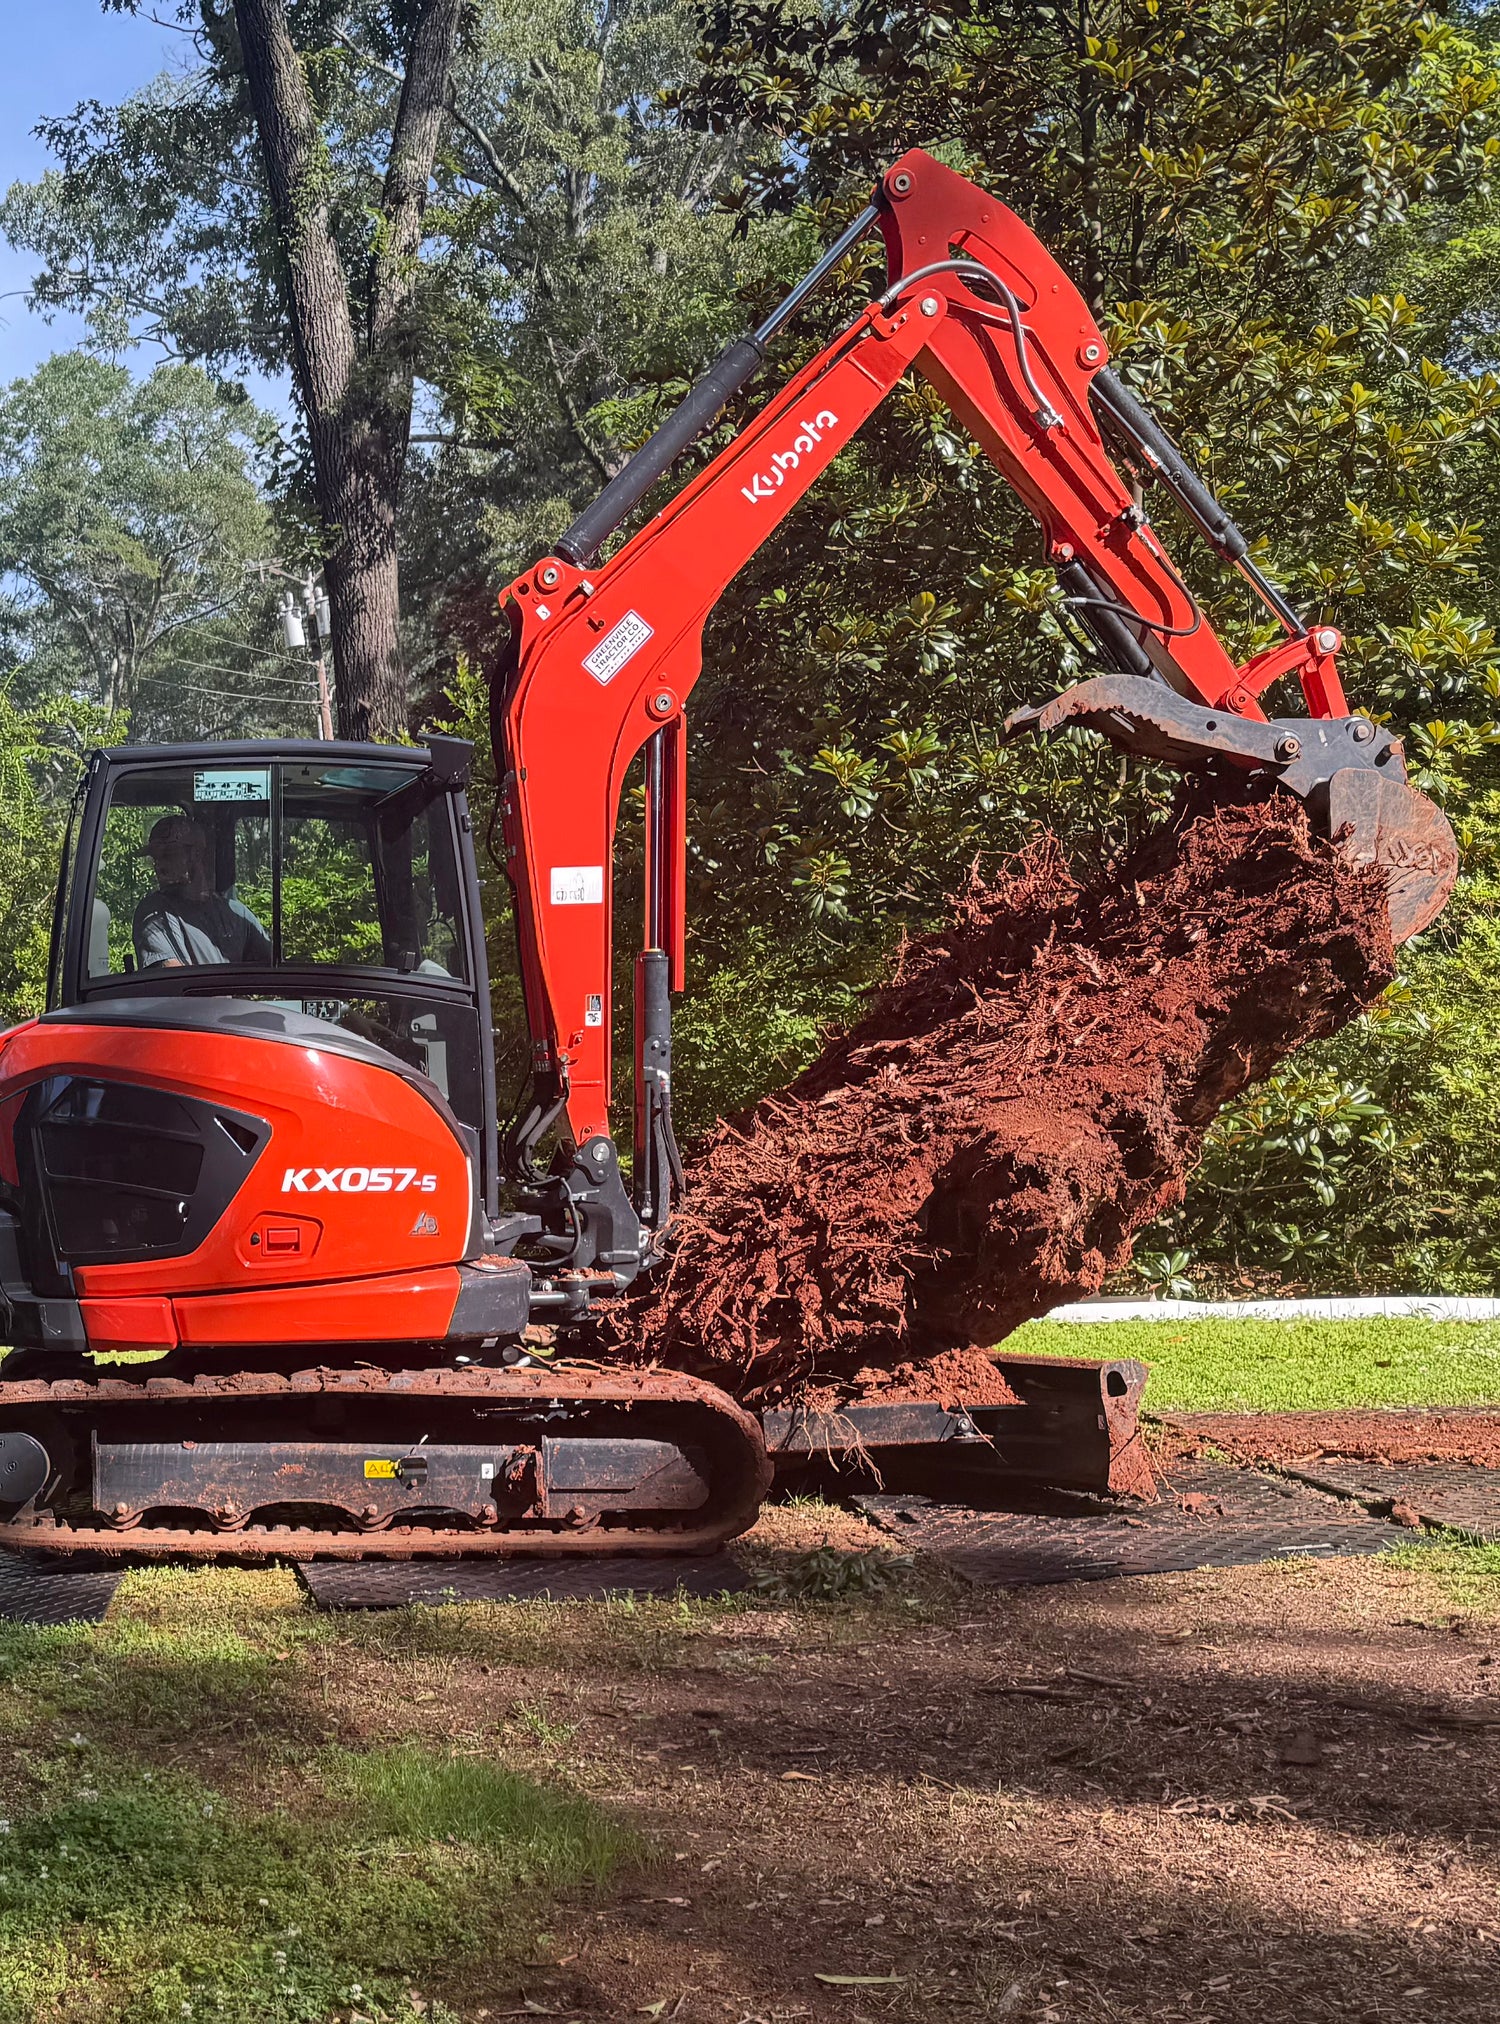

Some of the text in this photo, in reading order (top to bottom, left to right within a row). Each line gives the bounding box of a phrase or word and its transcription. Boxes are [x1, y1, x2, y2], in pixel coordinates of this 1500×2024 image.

[740, 409, 839, 504] Kubota
[591, 618, 634, 664] GREENVILLE
[595, 635, 628, 670] TRACTOR
[627, 623, 640, 636] CO
